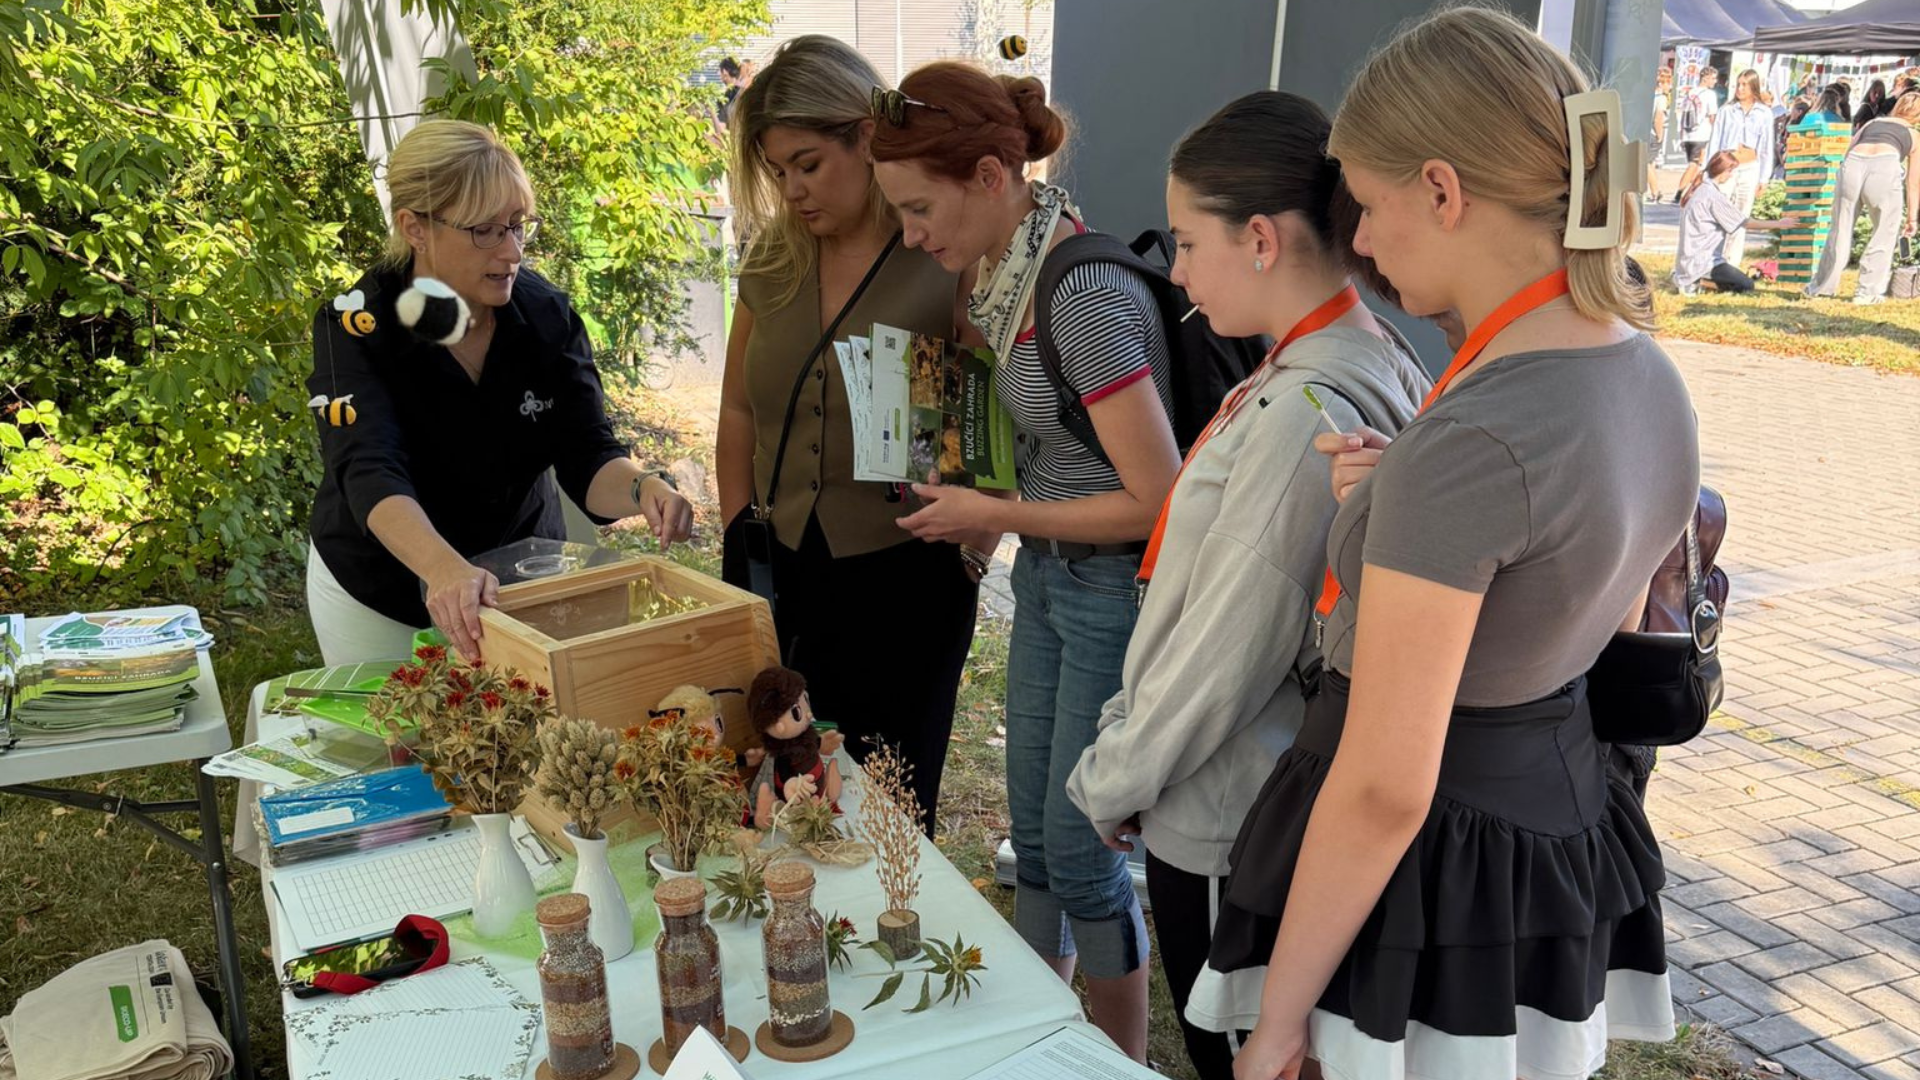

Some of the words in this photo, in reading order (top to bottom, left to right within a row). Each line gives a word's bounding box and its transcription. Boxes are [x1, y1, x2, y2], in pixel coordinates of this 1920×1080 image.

[967, 374, 976, 419] ZAHRADA
[977, 380, 985, 418] GARDEN
[965, 420, 975, 460] BZUČÍCÍ
[976, 419, 985, 456] BUZZING
